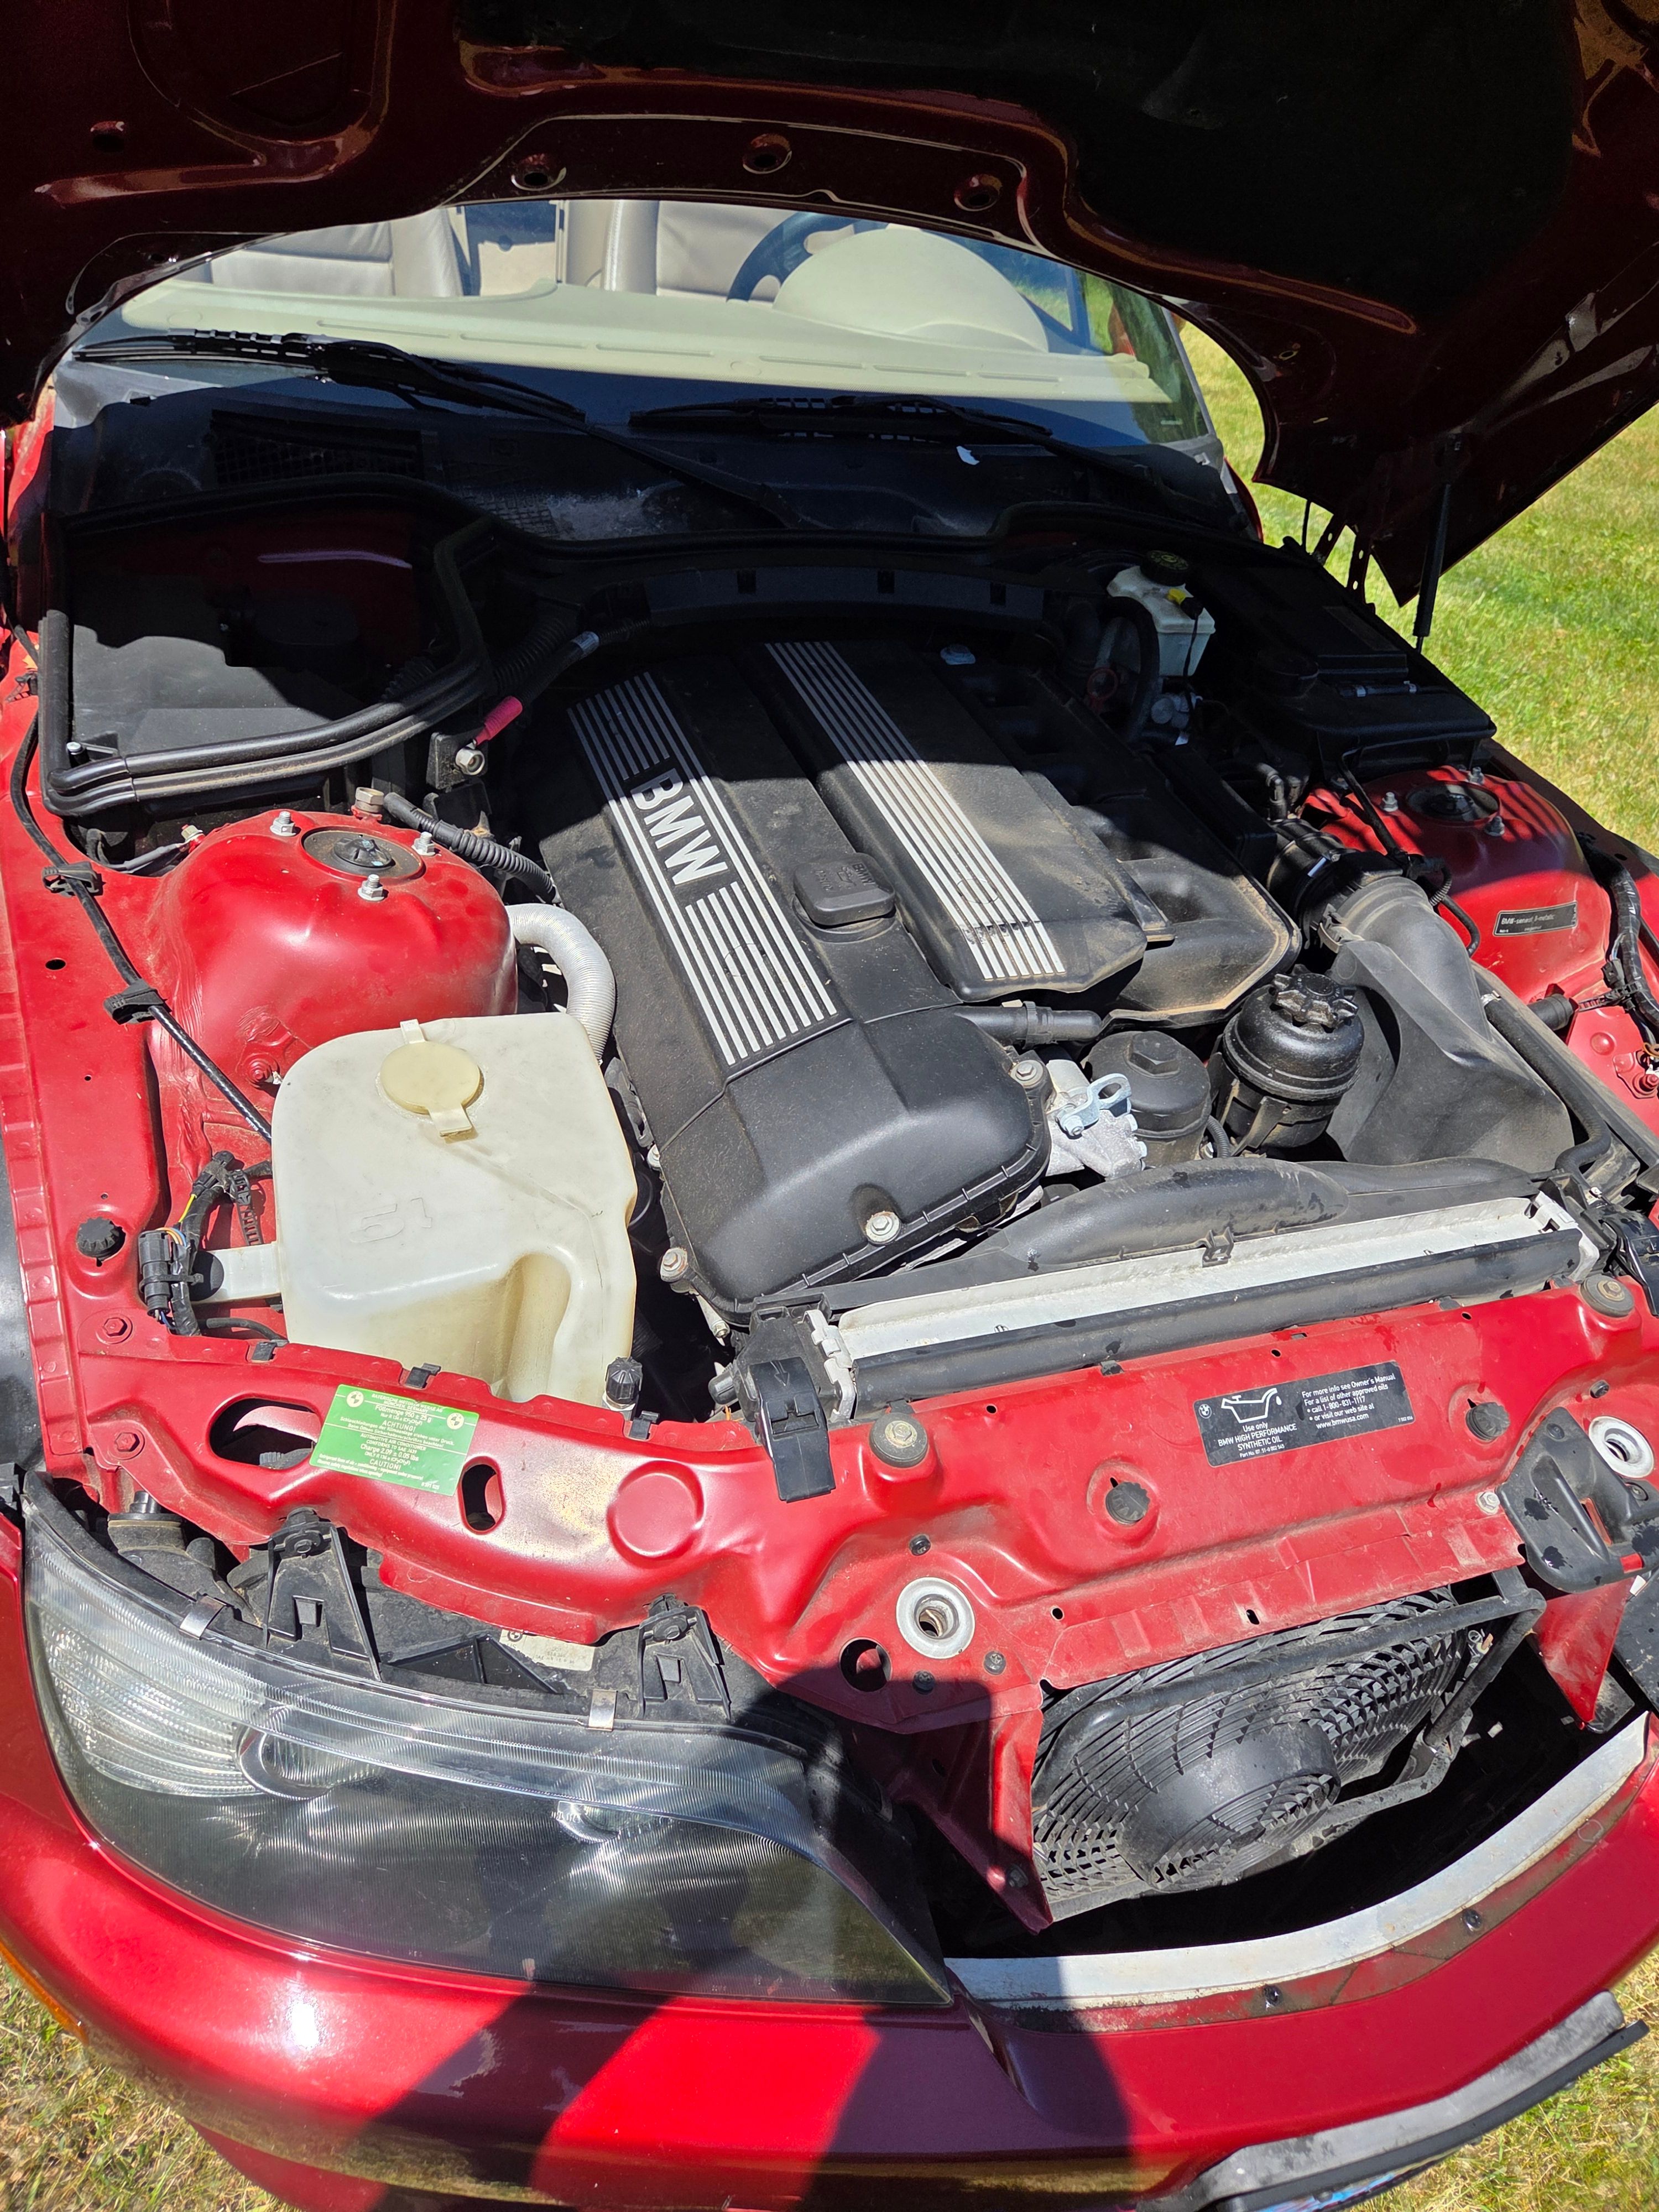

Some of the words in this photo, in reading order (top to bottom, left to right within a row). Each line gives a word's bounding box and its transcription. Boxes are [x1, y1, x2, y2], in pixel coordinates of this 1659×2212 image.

[630, 768, 728, 885] BMW
[1351, 1378, 1374, 1387] Owner's
[1374, 1373, 1395, 1383] Manual
[1352, 1385, 1378, 1397] approved
[1322, 1395, 1365, 1410] 1-800-831-1117
[375, 1404, 404, 1416] Füllmenge
[382, 1420, 416, 1432] ACHTUNG!
[1316, 1413, 1369, 1428] www.bmwusa.com
[361, 1433, 388, 1442] AUTOMOTIVE
[397, 1441, 426, 1450] CONDITIONER
[1218, 1437, 1233, 1446] BMW
[1235, 1433, 1250, 1443] HIGH
[1251, 1423, 1297, 1439] PERFORMANCE
[361, 1443, 380, 1453] Charge
[367, 1439, 390, 1448] CONFORMS
[1238, 1437, 1271, 1451] SYNTHETIC
[369, 1459, 401, 1470] CAUTION!
